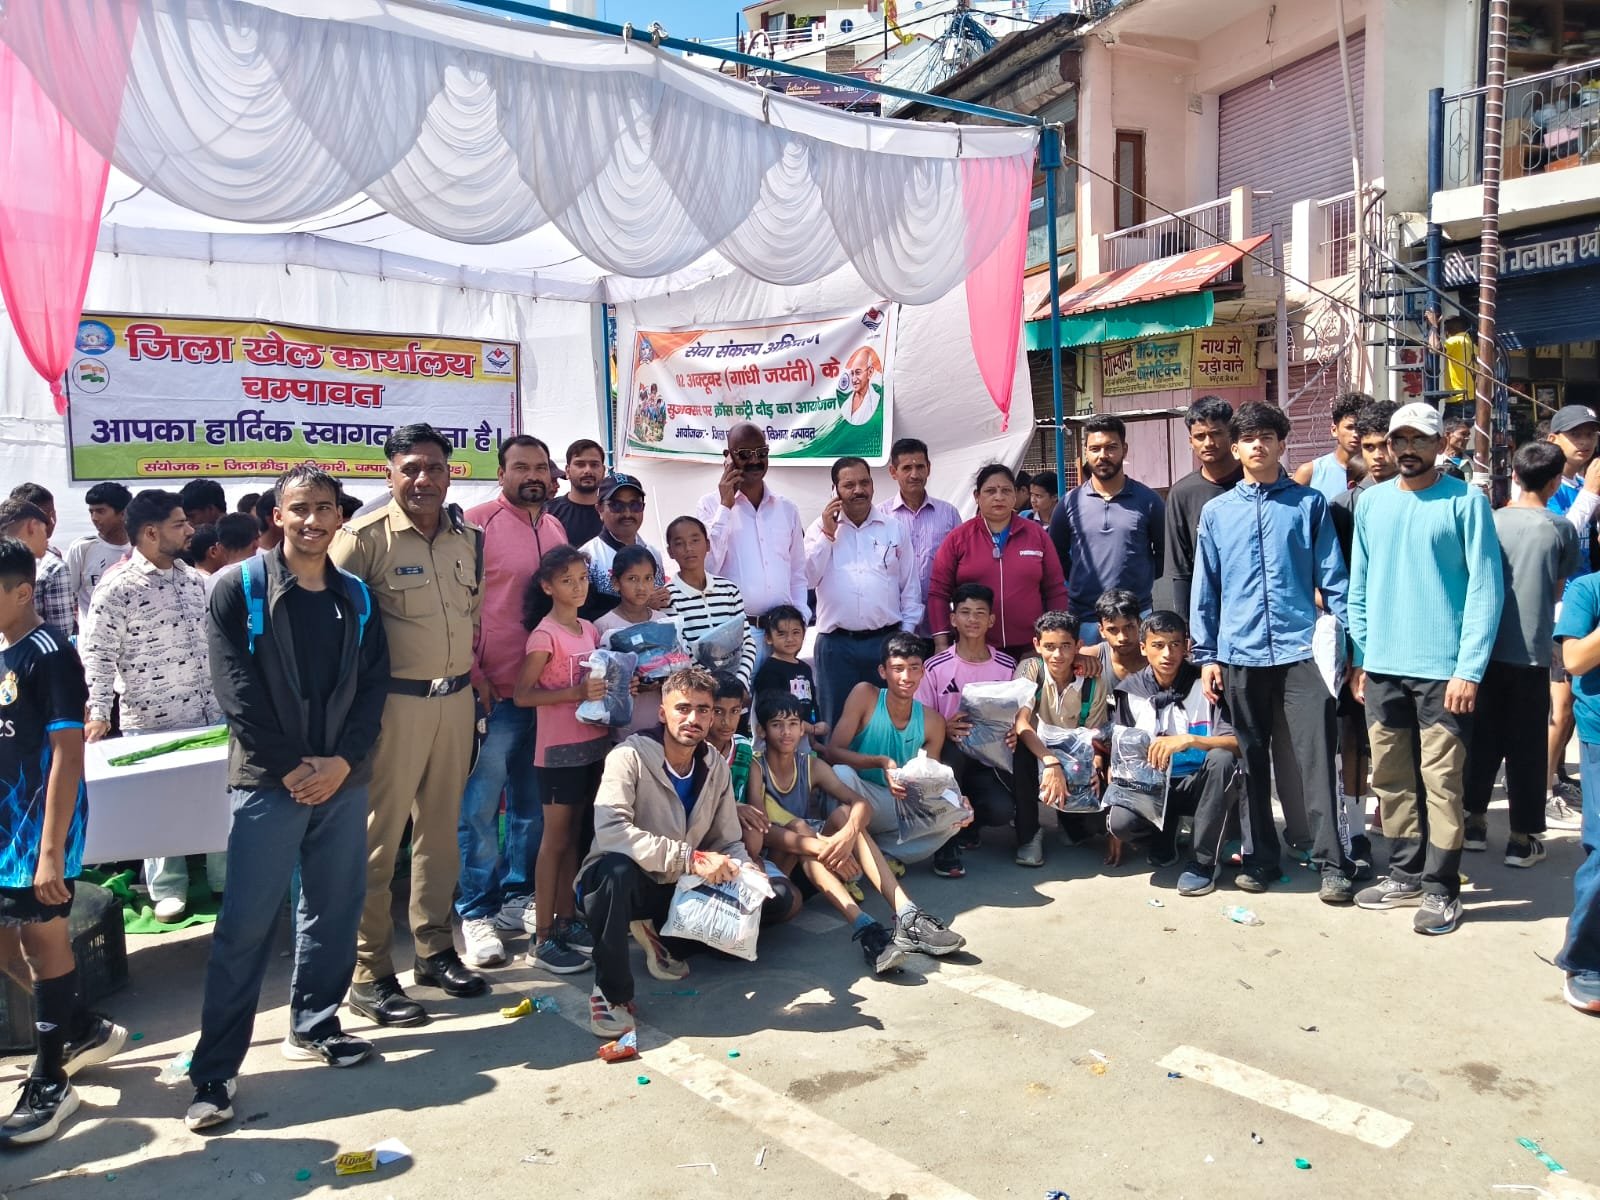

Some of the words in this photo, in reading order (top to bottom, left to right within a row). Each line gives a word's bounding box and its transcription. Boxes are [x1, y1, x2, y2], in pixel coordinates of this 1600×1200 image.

[124, 323, 235, 363] जिला
[242, 330, 325, 368] खेल
[330, 341, 476, 378] कार्यालय
[685, 341, 715, 358] सेवा
[716, 339, 763, 358] संकल्प
[1200, 339, 1225, 355] नाथ
[1227, 335, 1242, 355] जी
[725, 364, 760, 392] (गांधी
[762, 358, 815, 387] जयंती)
[820, 356, 840, 378] के
[1223, 355, 1244, 373] वाले
[241, 376, 385, 408] चम्पावत
[776, 402, 792, 414] का
[90, 418, 197, 444] आपका
[203, 409, 296, 446] हार्दिक
[143, 460, 200, 472] संयोजक
[223, 460, 257, 472] जिला
